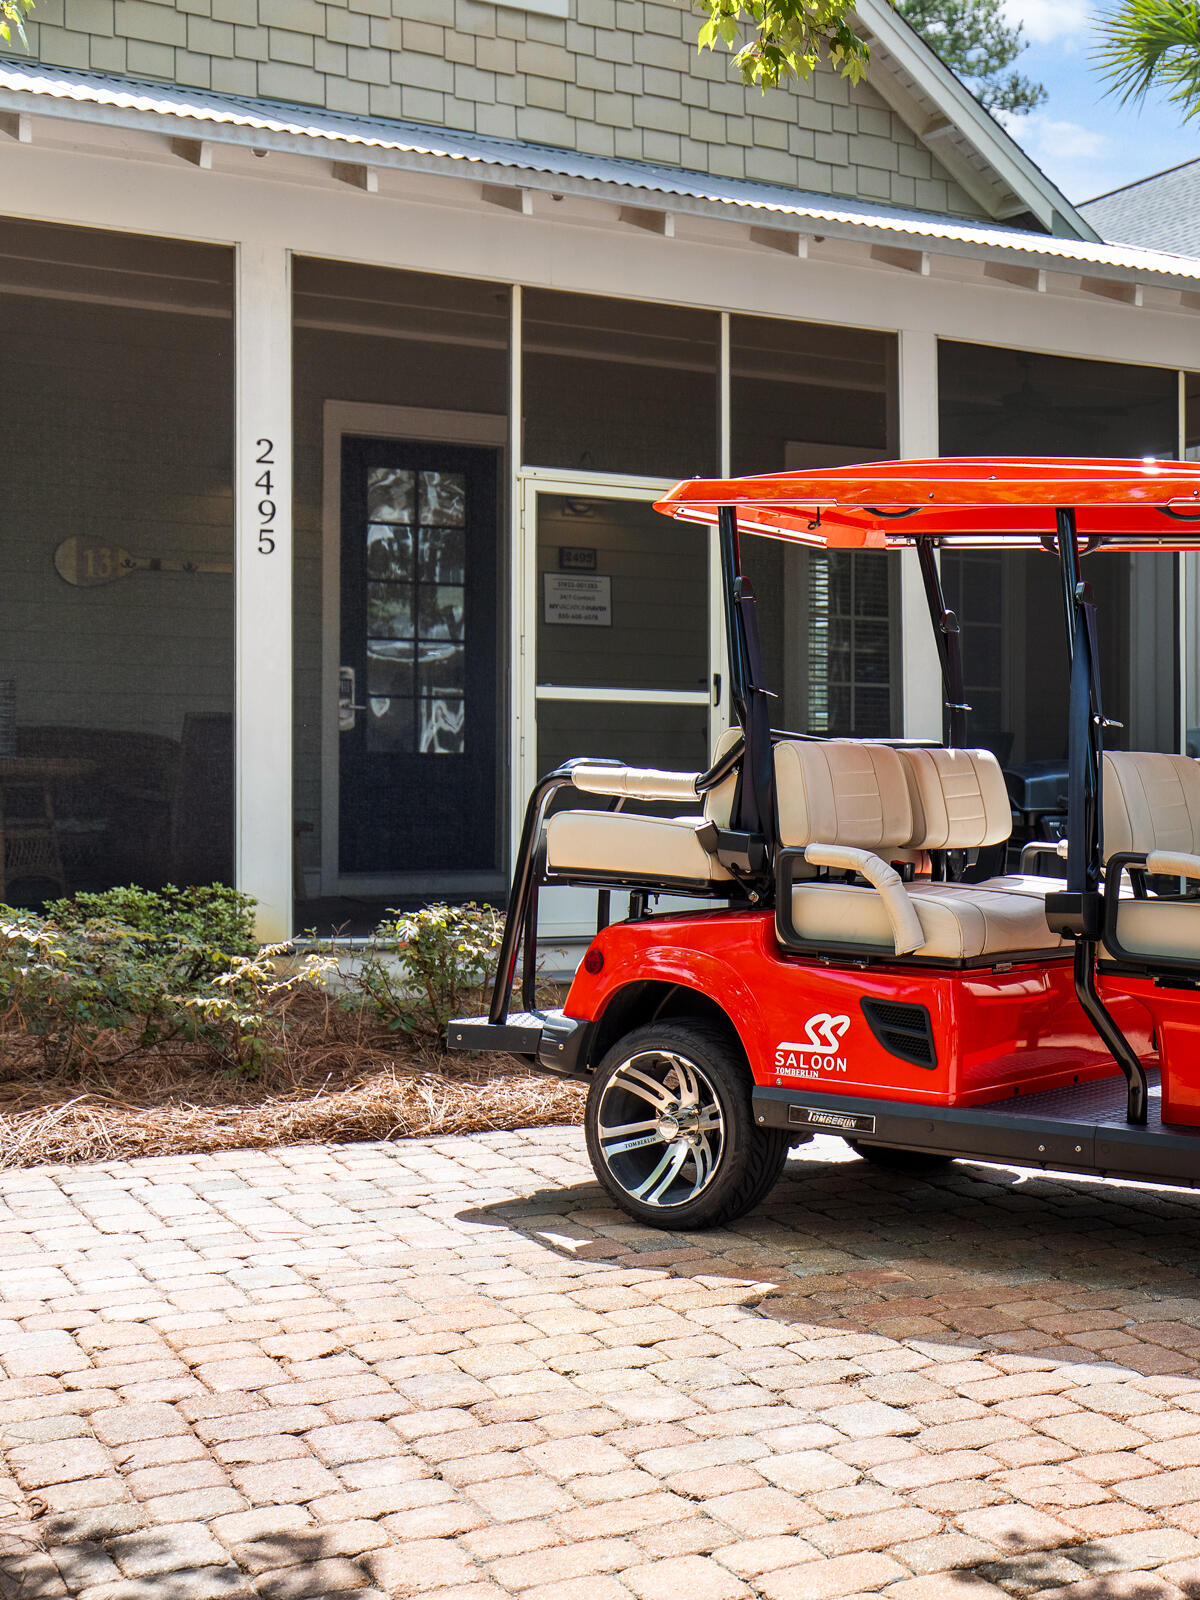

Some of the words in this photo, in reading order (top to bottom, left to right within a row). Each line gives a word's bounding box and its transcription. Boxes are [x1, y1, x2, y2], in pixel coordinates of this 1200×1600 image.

[255, 438, 276, 555] 2495
[82, 547, 112, 577] 13
[775, 1051, 847, 1072] SALOON
[775, 1066, 819, 1078] TOMBERLIN
[624, 1136, 657, 1149] TOMBERLIN
